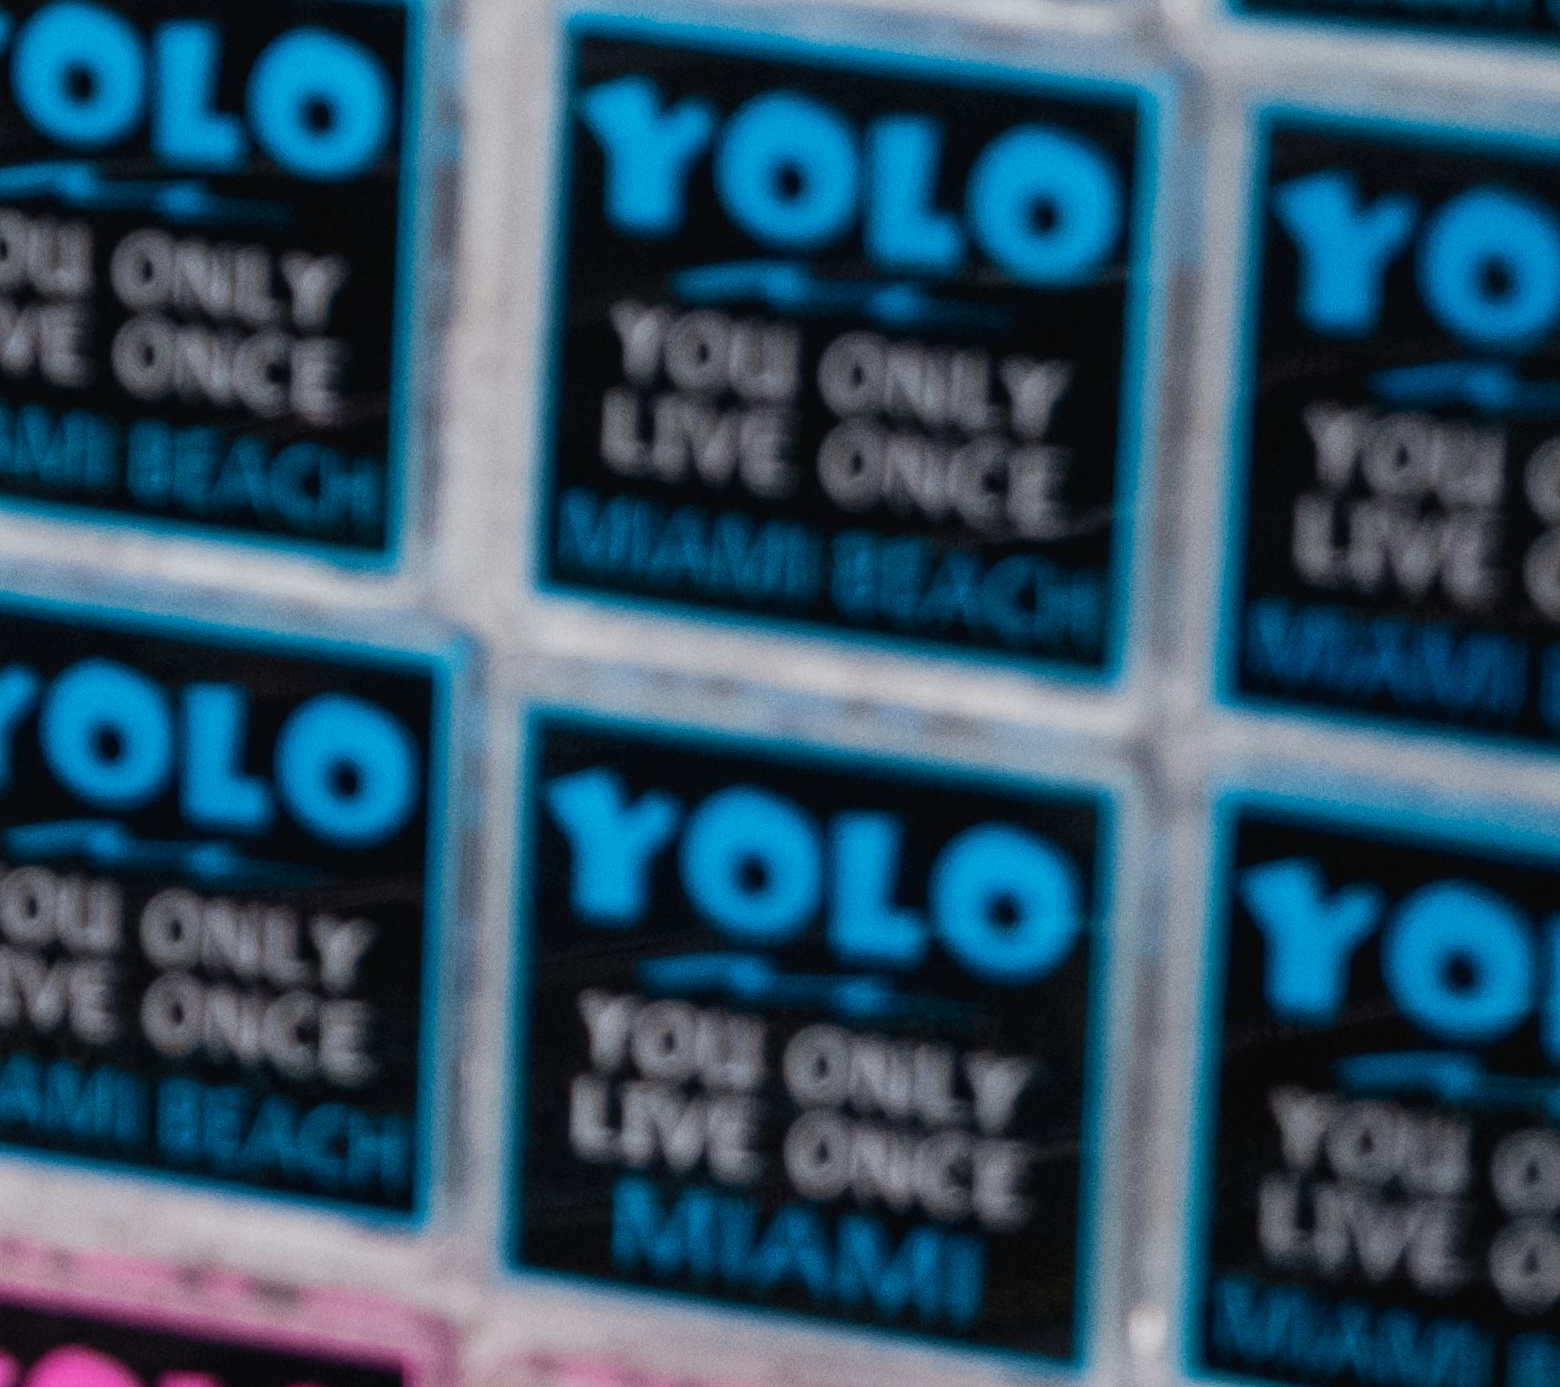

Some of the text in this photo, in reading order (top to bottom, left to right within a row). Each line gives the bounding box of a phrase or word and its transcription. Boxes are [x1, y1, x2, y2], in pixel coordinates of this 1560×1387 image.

[579, 76, 1122, 286] YOLO
[114, 231, 342, 329] ONLY
[114, 316, 339, 422] ONCE
[614, 308, 1068, 441] YOU ONLY
[130, 422, 380, 525] BEACH
[600, 395, 1065, 539] LIVE ONCE
[560, 487, 1101, 642] MIAMI BEACH
[144, 887, 375, 990] ONLY
[546, 770, 1082, 982] YOLO
[144, 974, 375, 1083] ONCE
[579, 990, 1033, 1134] YOU ONLY
[157, 1080, 410, 1186] BEACH
[570, 1072, 1030, 1230] LIVE ONCE
[614, 1181, 984, 1325] MIAMI
